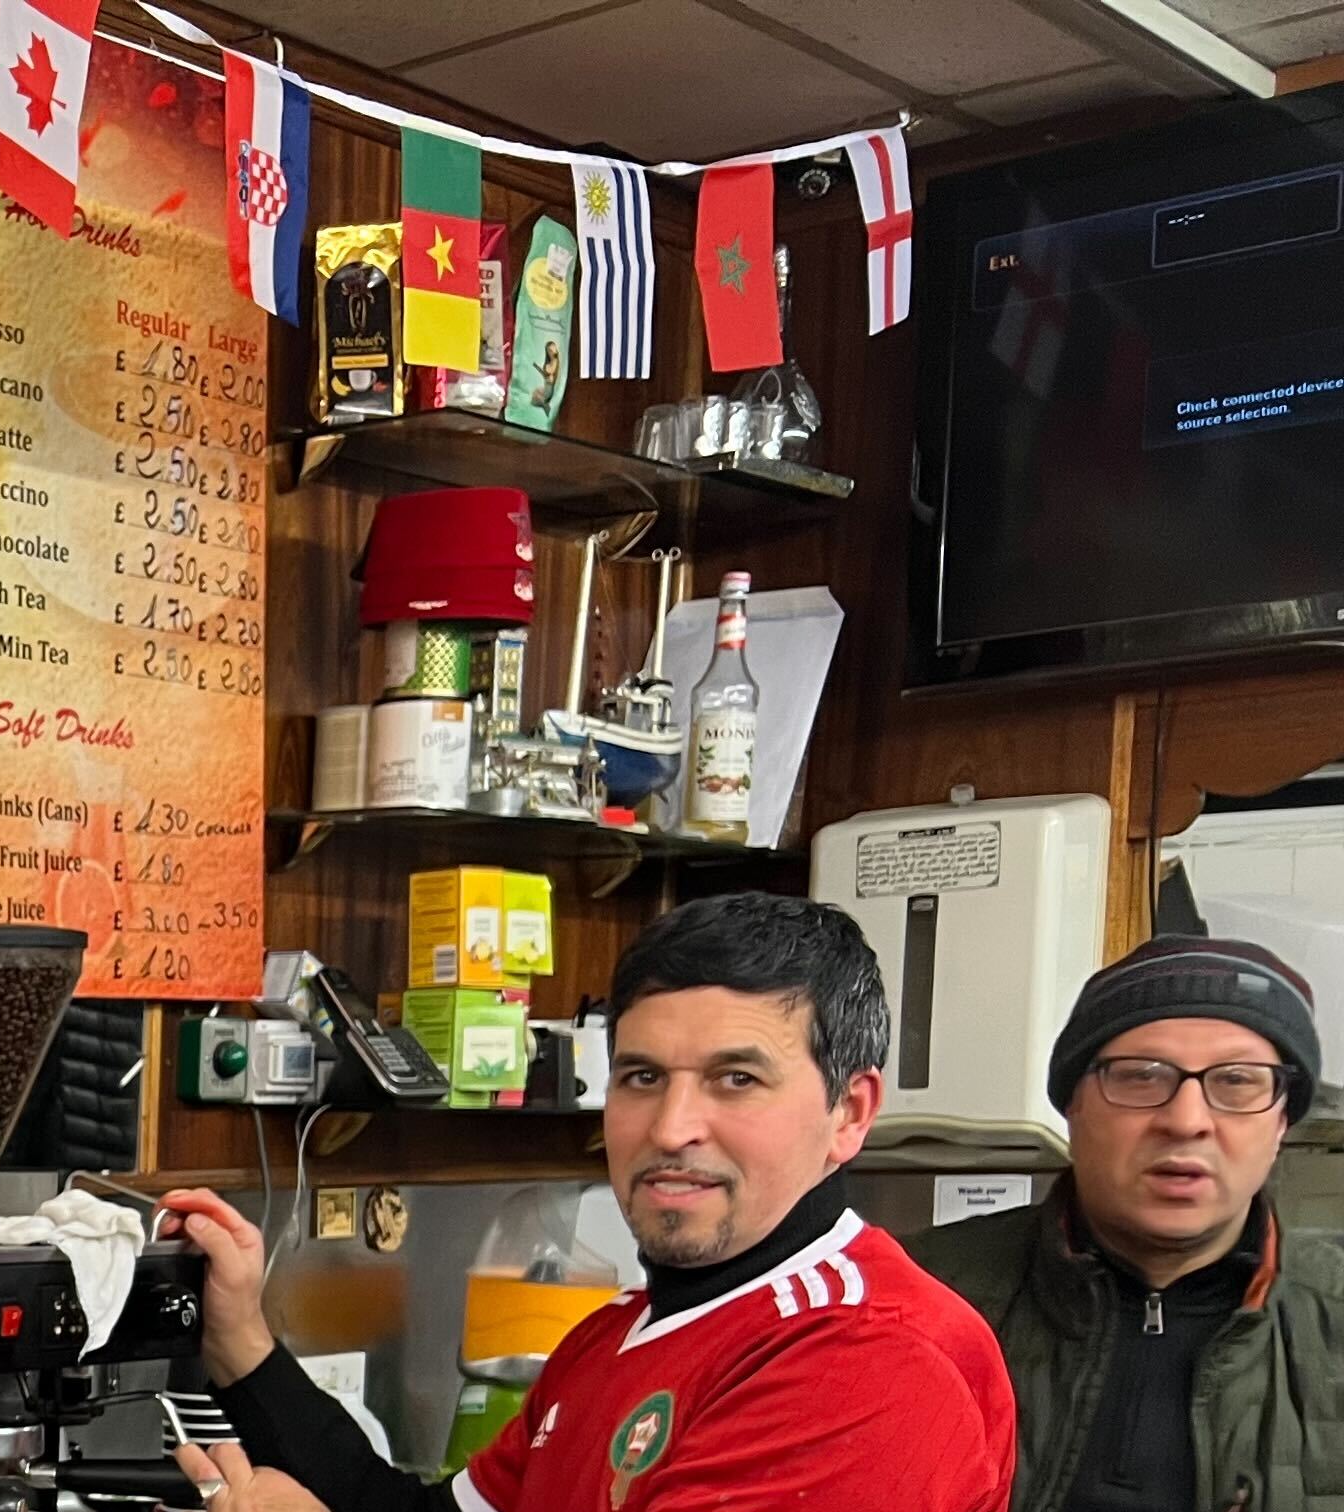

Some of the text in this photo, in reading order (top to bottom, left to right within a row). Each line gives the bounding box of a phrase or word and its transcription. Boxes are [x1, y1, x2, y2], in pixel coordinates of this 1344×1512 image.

[117, 300, 258, 364] Regular Large
[1176, 398, 1219, 416] Check
[1223, 384, 1295, 407] connected
[1177, 413, 1222, 431] source
[14, 584, 46, 611] Tea
[37, 640, 69, 666] Tea
[55, 707, 134, 750] Drinks
[38, 796, 89, 828] (Cans)
[0, 845, 39, 870] Fruit
[43, 849, 83, 874] Juice
[7, 898, 45, 922] Juice
